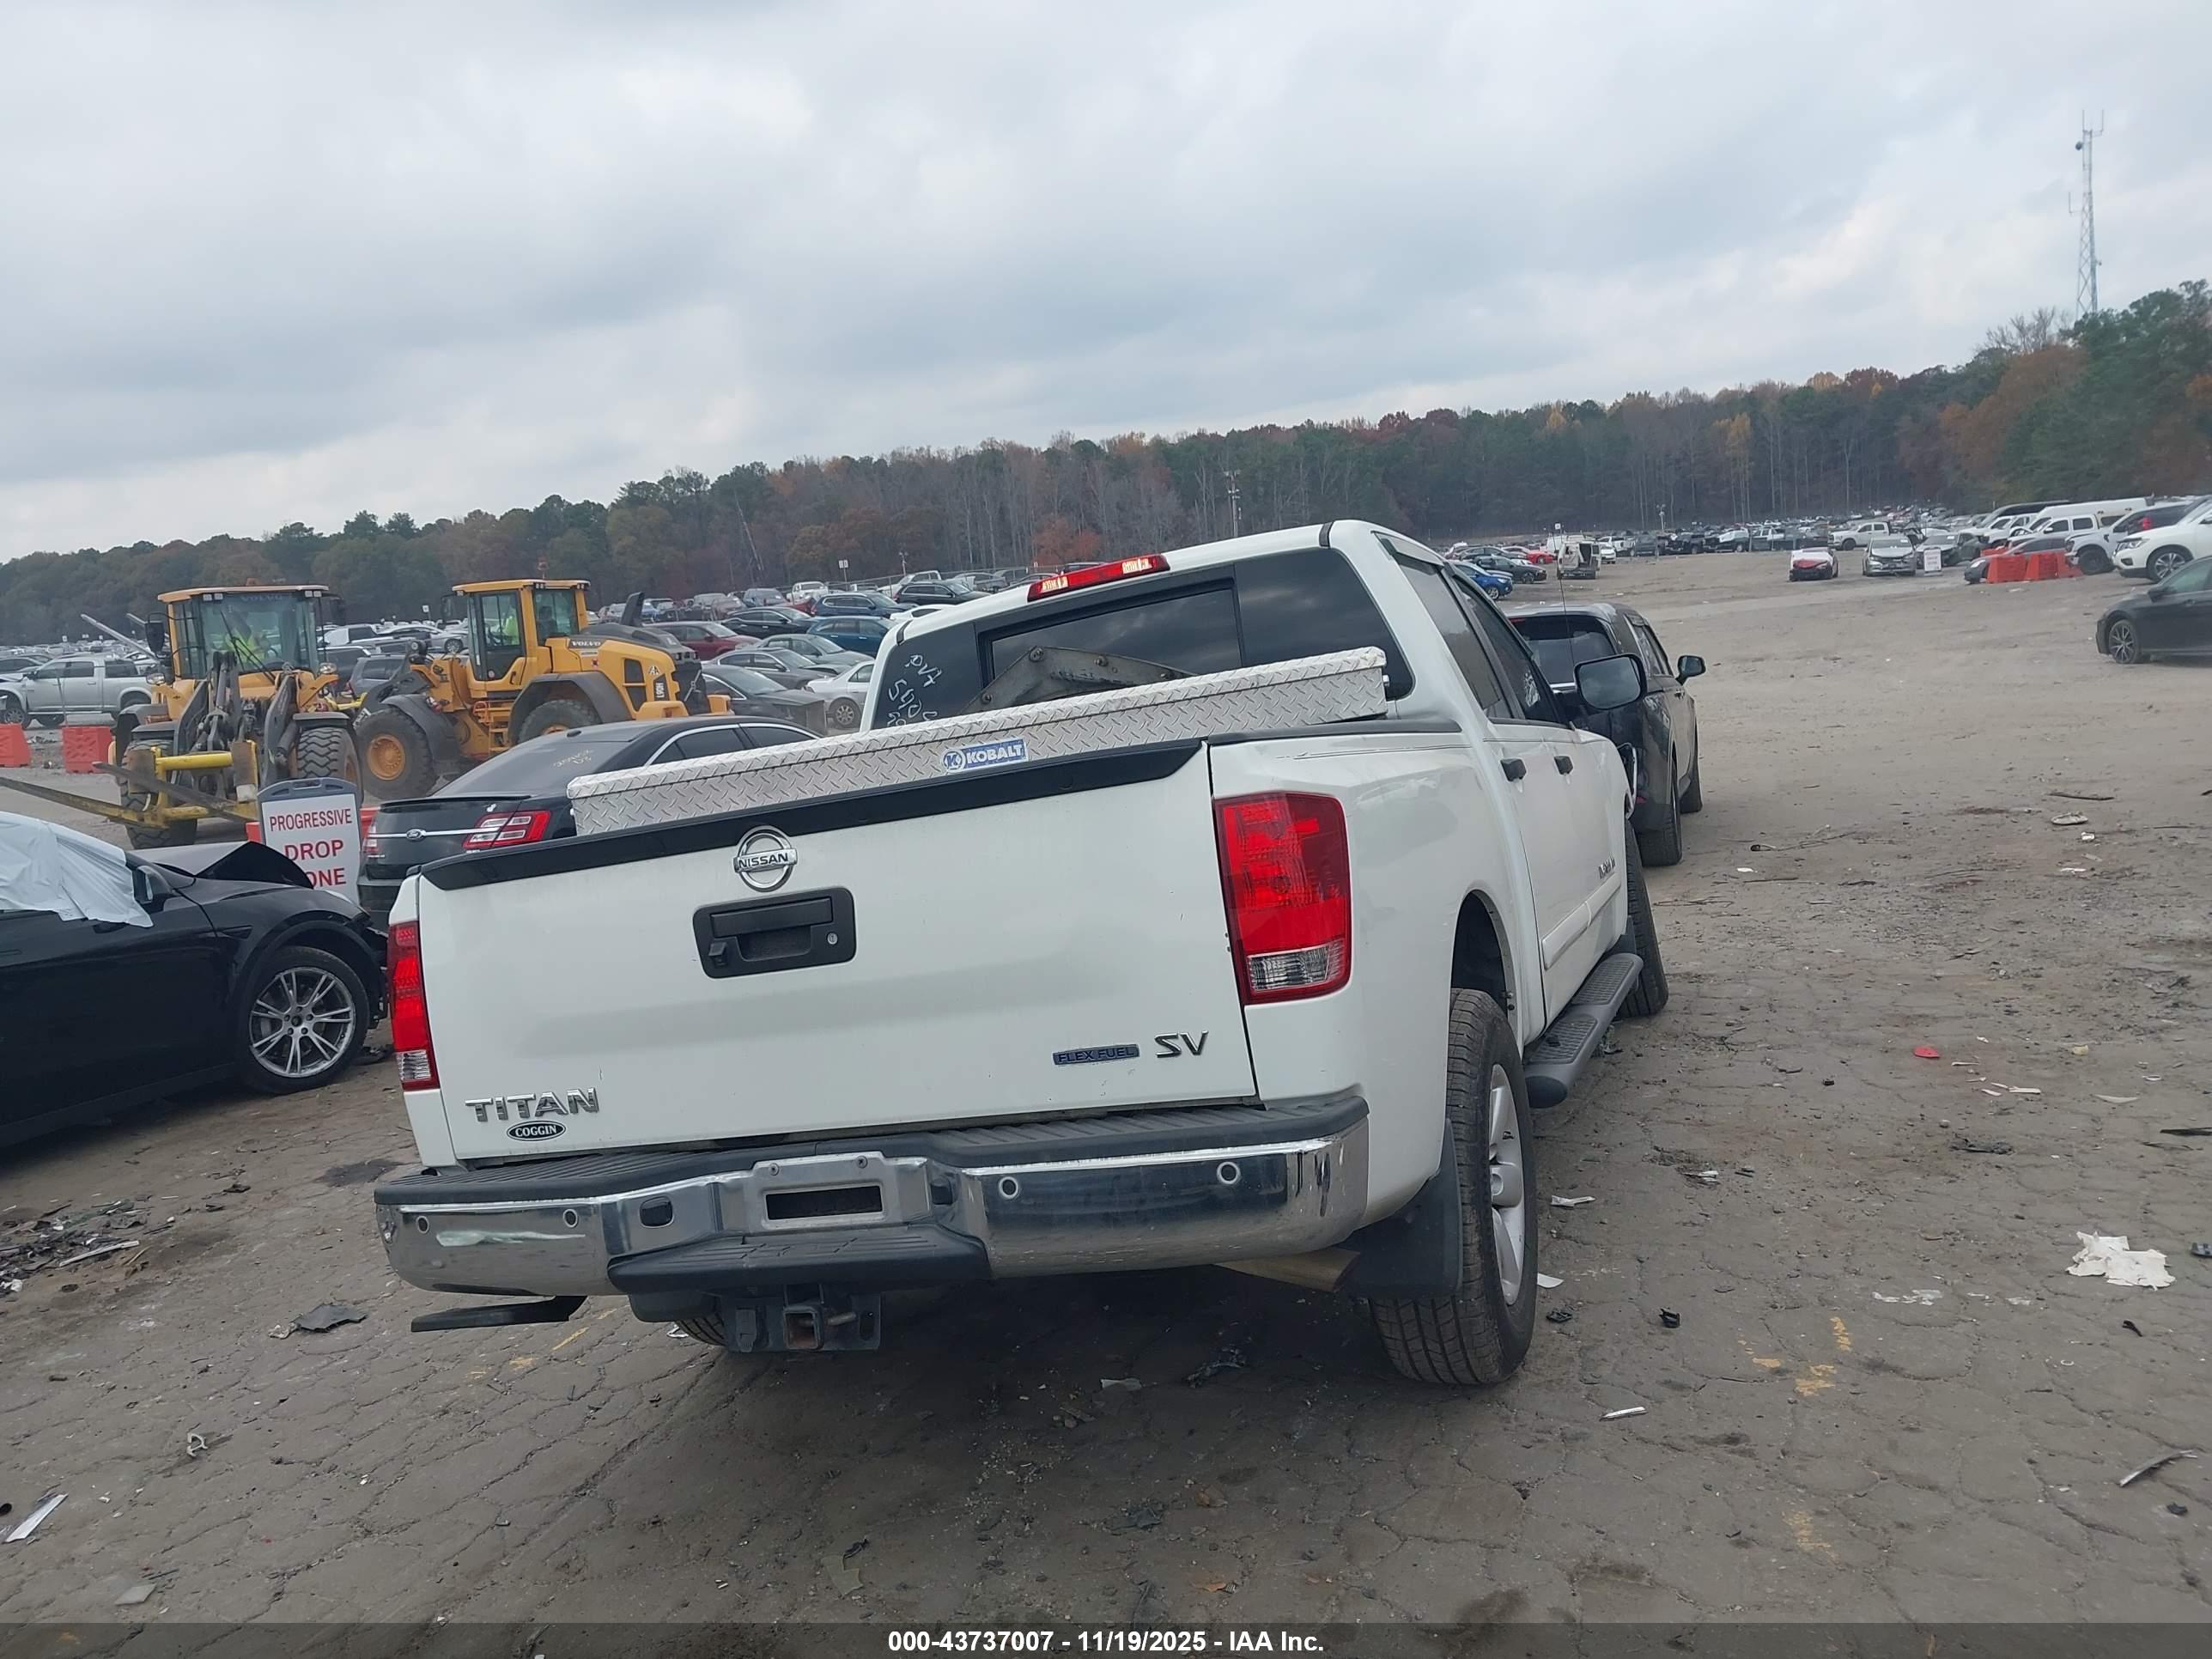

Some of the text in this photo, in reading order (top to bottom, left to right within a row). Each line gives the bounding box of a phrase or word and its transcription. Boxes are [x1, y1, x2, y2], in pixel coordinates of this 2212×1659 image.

[966, 744, 1023, 763] KOBALT
[270, 808, 352, 831] PROGRESSIVE
[284, 839, 343, 861] DROP
[738, 853, 788, 868] NISSAN
[305, 867, 347, 887] ONE
[1154, 1030, 1208, 1058] SV
[1058, 1046, 1134, 1063] FLEX FUEL
[465, 1087, 599, 1122] TITAN
[514, 1125, 558, 1138] COGGIN
